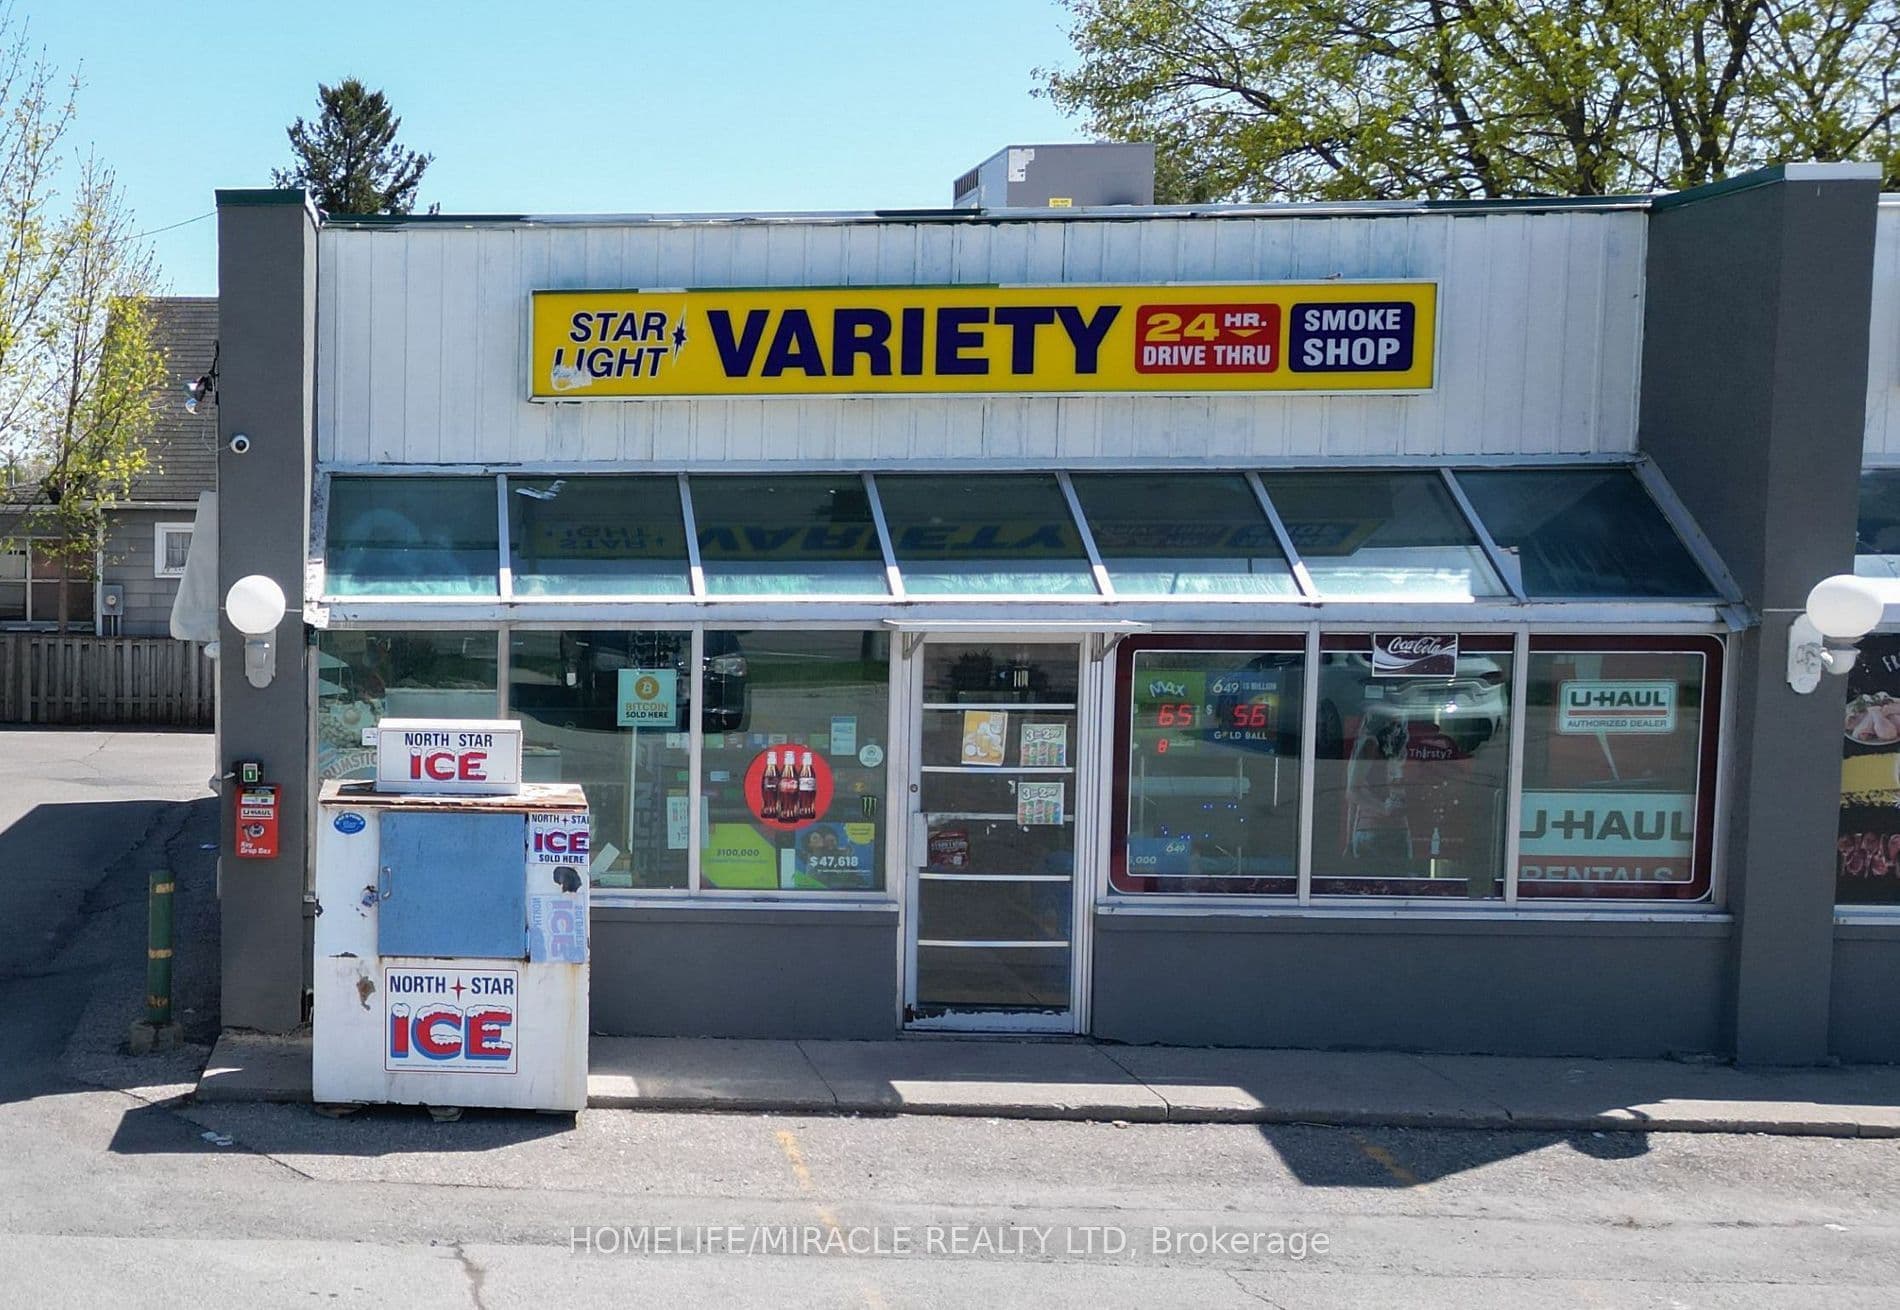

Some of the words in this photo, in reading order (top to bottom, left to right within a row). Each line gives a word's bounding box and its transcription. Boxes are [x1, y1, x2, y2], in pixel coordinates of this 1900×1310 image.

[569, 311, 668, 343] STAR
[1144, 312, 1220, 342] 24
[1224, 312, 1268, 328] HR.
[1303, 309, 1401, 332] SMOKE
[706, 305, 1122, 377] VARIETY
[1302, 337, 1400, 366] SHOP
[1143, 345, 1206, 366] DRIVE
[1213, 344, 1272, 366] THRU
[1149, 681, 1185, 697] MAX
[1570, 691, 1666, 706] U-HAUL
[625, 702, 668, 711] BITCOIN
[625, 711, 647, 719] SOLD
[648, 711, 669, 719] HERE
[1158, 704, 1192, 727] 65
[1233, 704, 1266, 727] 56
[1567, 719, 1628, 728] AUTHORIZED
[1630, 719, 1667, 728] DEALER
[404, 732, 450, 747] NORTH
[458, 733, 493, 748] STAR
[410, 747, 488, 781] ICE
[1408, 748, 1453, 761] Thirsty?
[531, 813, 560, 824] NORTH
[571, 815, 589, 825] STA
[533, 828, 589, 855] ICE
[538, 853, 561, 864] SOLD
[562, 854, 585, 864] HERE
[809, 855, 859, 868] $47,618
[389, 975, 446, 995] NORTH
[471, 976, 514, 996] STAR
[390, 1002, 513, 1061] ICE
